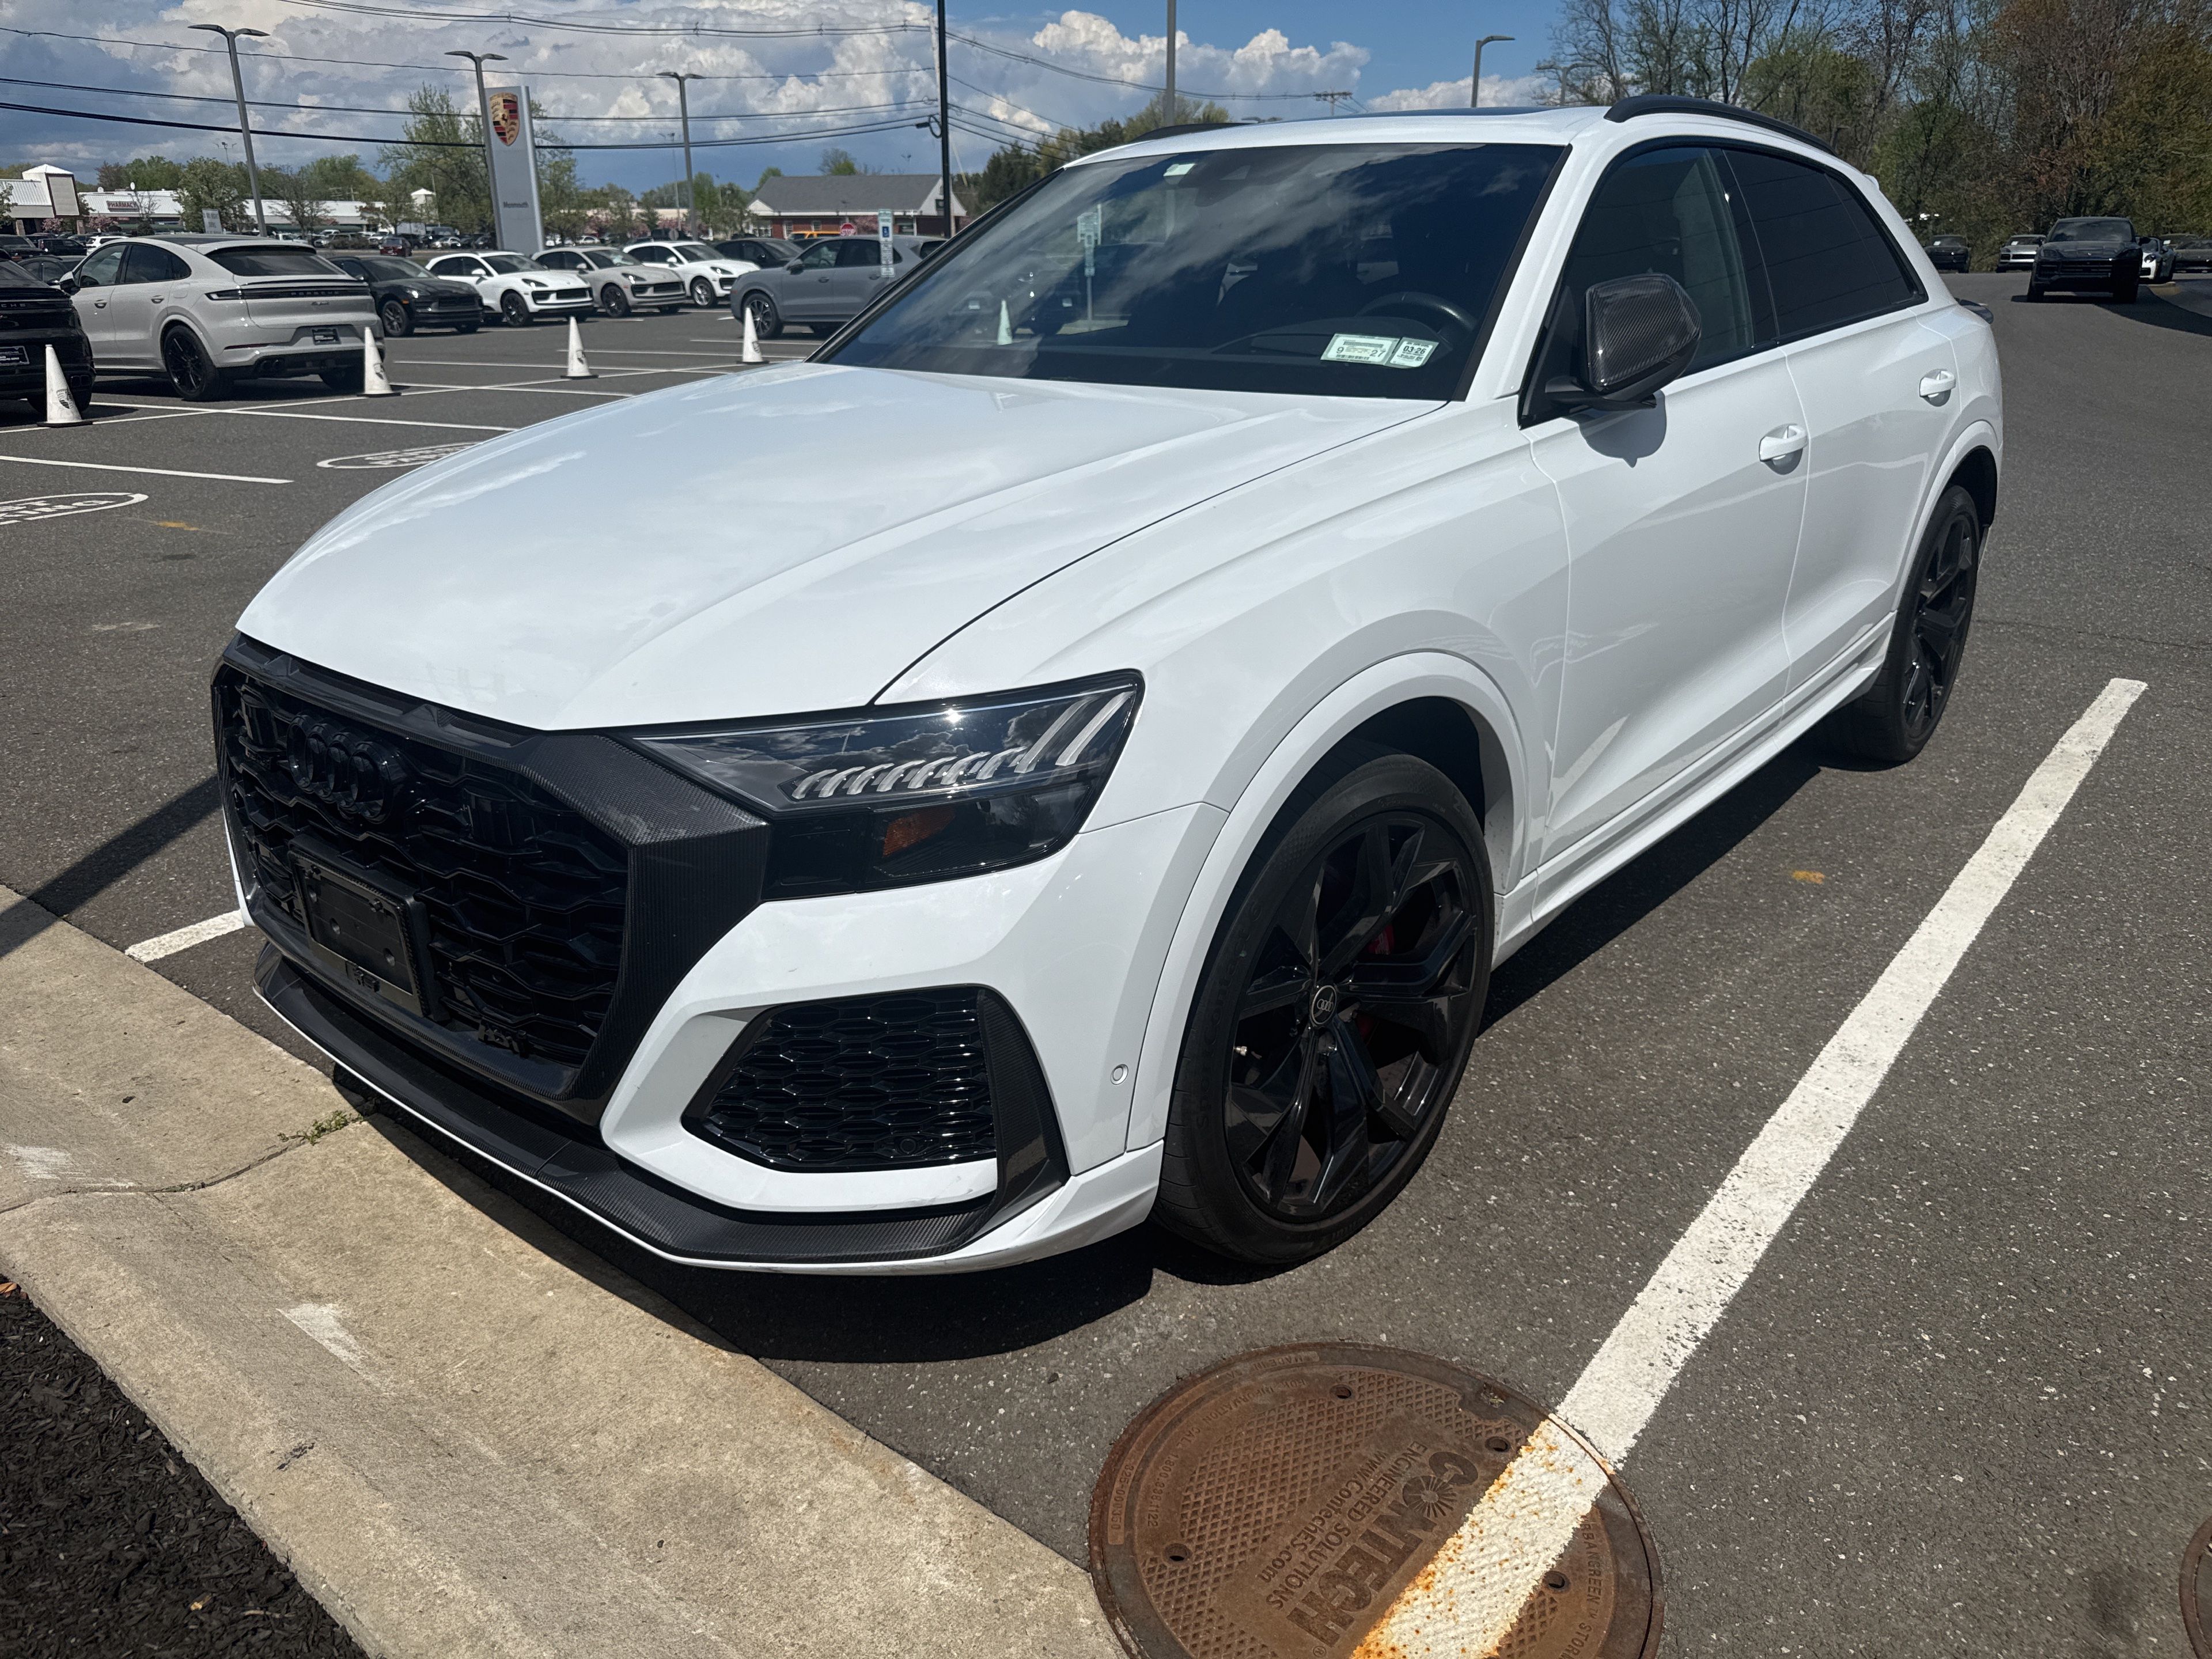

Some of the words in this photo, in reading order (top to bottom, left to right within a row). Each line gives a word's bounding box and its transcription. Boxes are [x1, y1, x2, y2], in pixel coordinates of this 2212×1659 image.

[1253, 1360, 1267, 1371] IN
[1270, 1355, 1303, 1368] MADE
[1176, 1427, 1202, 1447] CALL
[1347, 1441, 1427, 1522] ENGINEERED
[1266, 1521, 1351, 1610] SOLUTIONS
[1286, 1451, 1478, 1647] CONTECH
